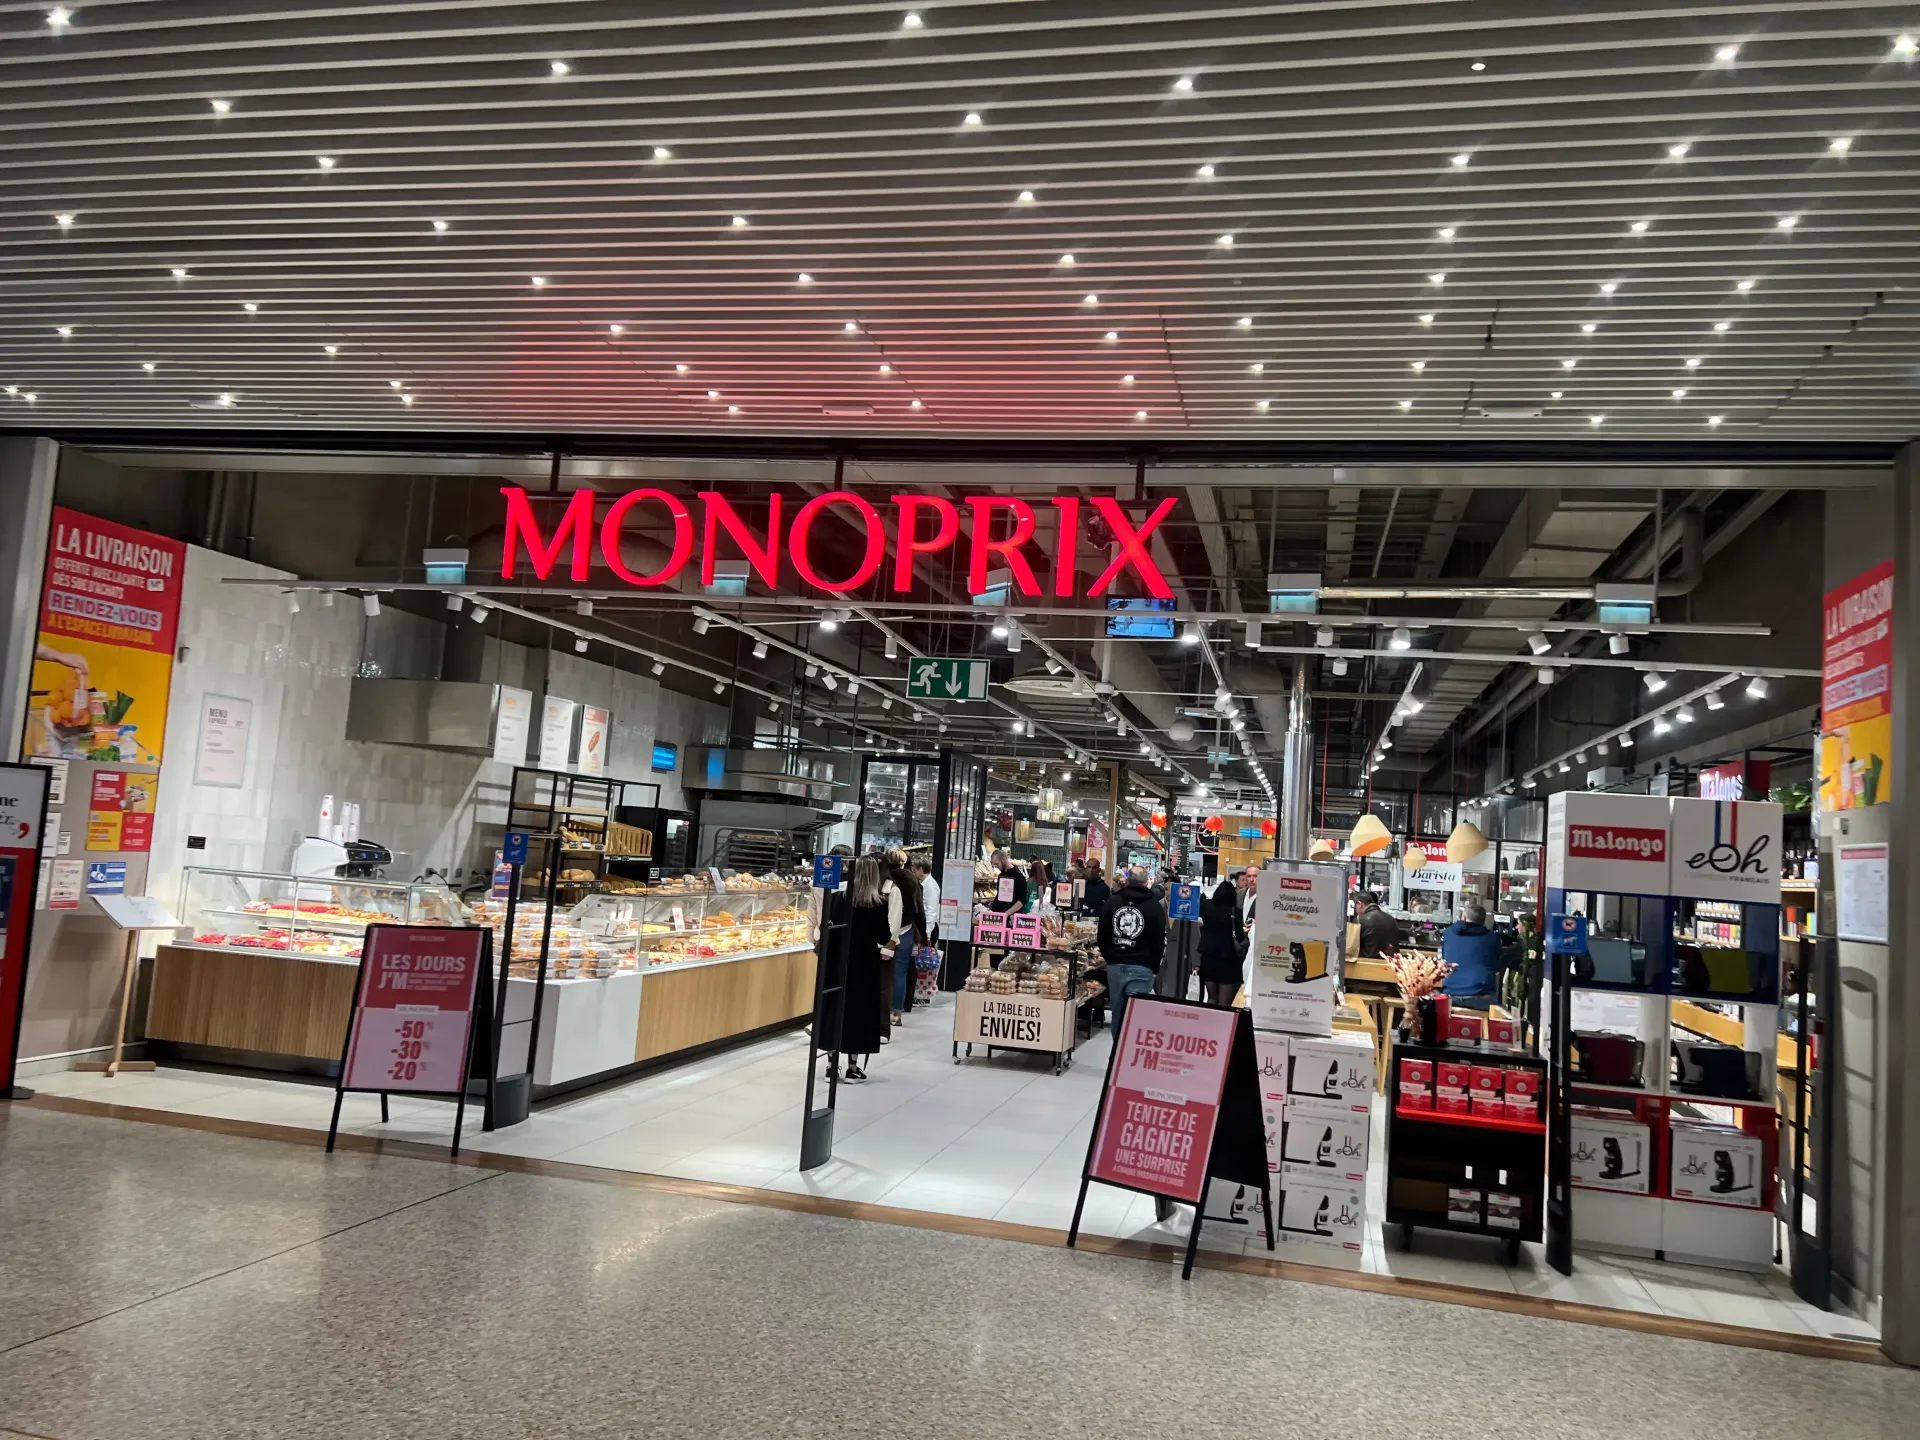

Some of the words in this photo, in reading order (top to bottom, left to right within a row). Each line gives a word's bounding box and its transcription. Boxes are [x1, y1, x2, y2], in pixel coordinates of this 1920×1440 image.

[56, 524, 80, 555] LA
[85, 531, 173, 577] LIVRAISON
[500, 487, 1178, 598] MONOPRIX
[51, 593, 158, 627] RENDEZ-VOUS
[1571, 828, 1664, 857] Malongo
[1411, 868, 1456, 881] Barista
[1273, 900, 1319, 914] Printemps
[381, 954, 411, 970] LES
[414, 955, 466, 972] JOURS
[377, 972, 409, 989] J'M
[983, 1001, 994, 1013] LA
[997, 1002, 1023, 1016] TABLE
[1025, 1006, 1040, 1018] DES
[980, 1016, 1041, 1042] ENVIES!
[1135, 1028, 1164, 1048] LES
[1166, 1034, 1218, 1057] JOURS
[1130, 1048, 1160, 1070] J'M
[1127, 1101, 1177, 1128] TENTEZ
[1178, 1112, 1198, 1133] DE
[1120, 1122, 1193, 1160] GAGNER
[1115, 1148, 1136, 1166] UNE
[1137, 1153, 1188, 1178] SURPRISE
